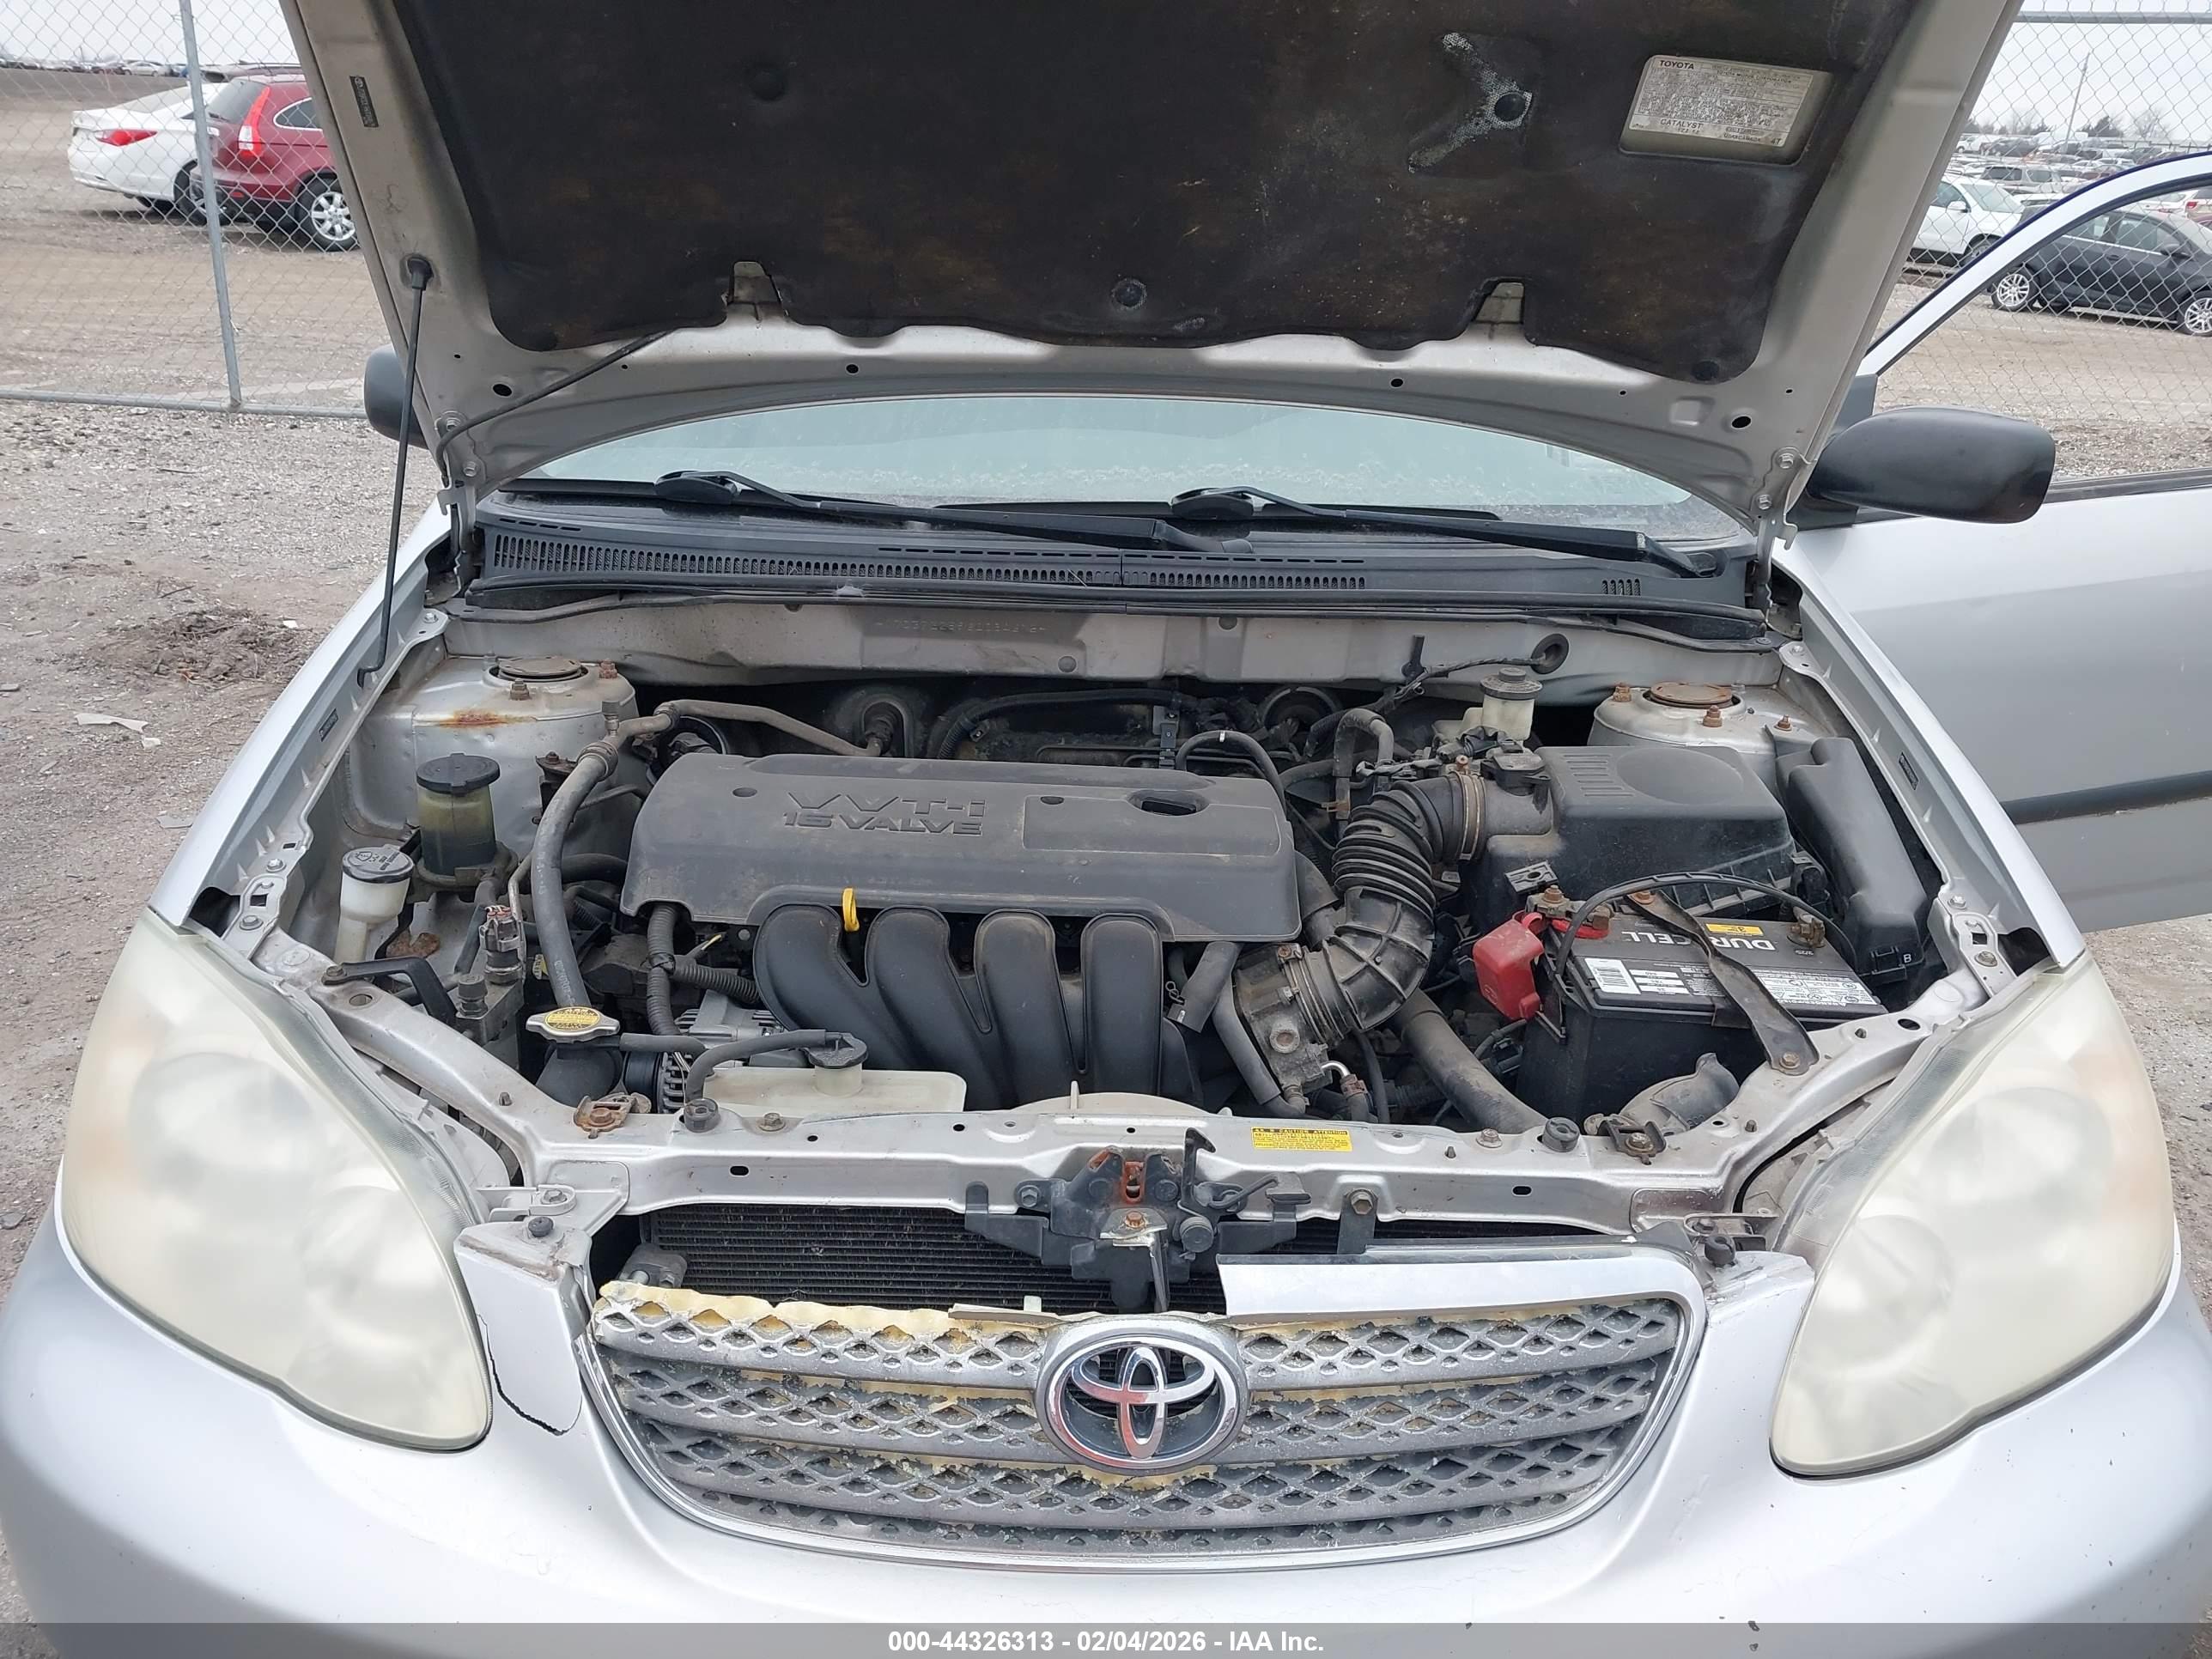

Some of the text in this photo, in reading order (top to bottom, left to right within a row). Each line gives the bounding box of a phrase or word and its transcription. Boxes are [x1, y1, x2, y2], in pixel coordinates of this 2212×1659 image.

[1658, 59, 1695, 70] TOYOTA
[1660, 118, 1705, 130] CATALYST
[1903, 953, 1912, 963] B
